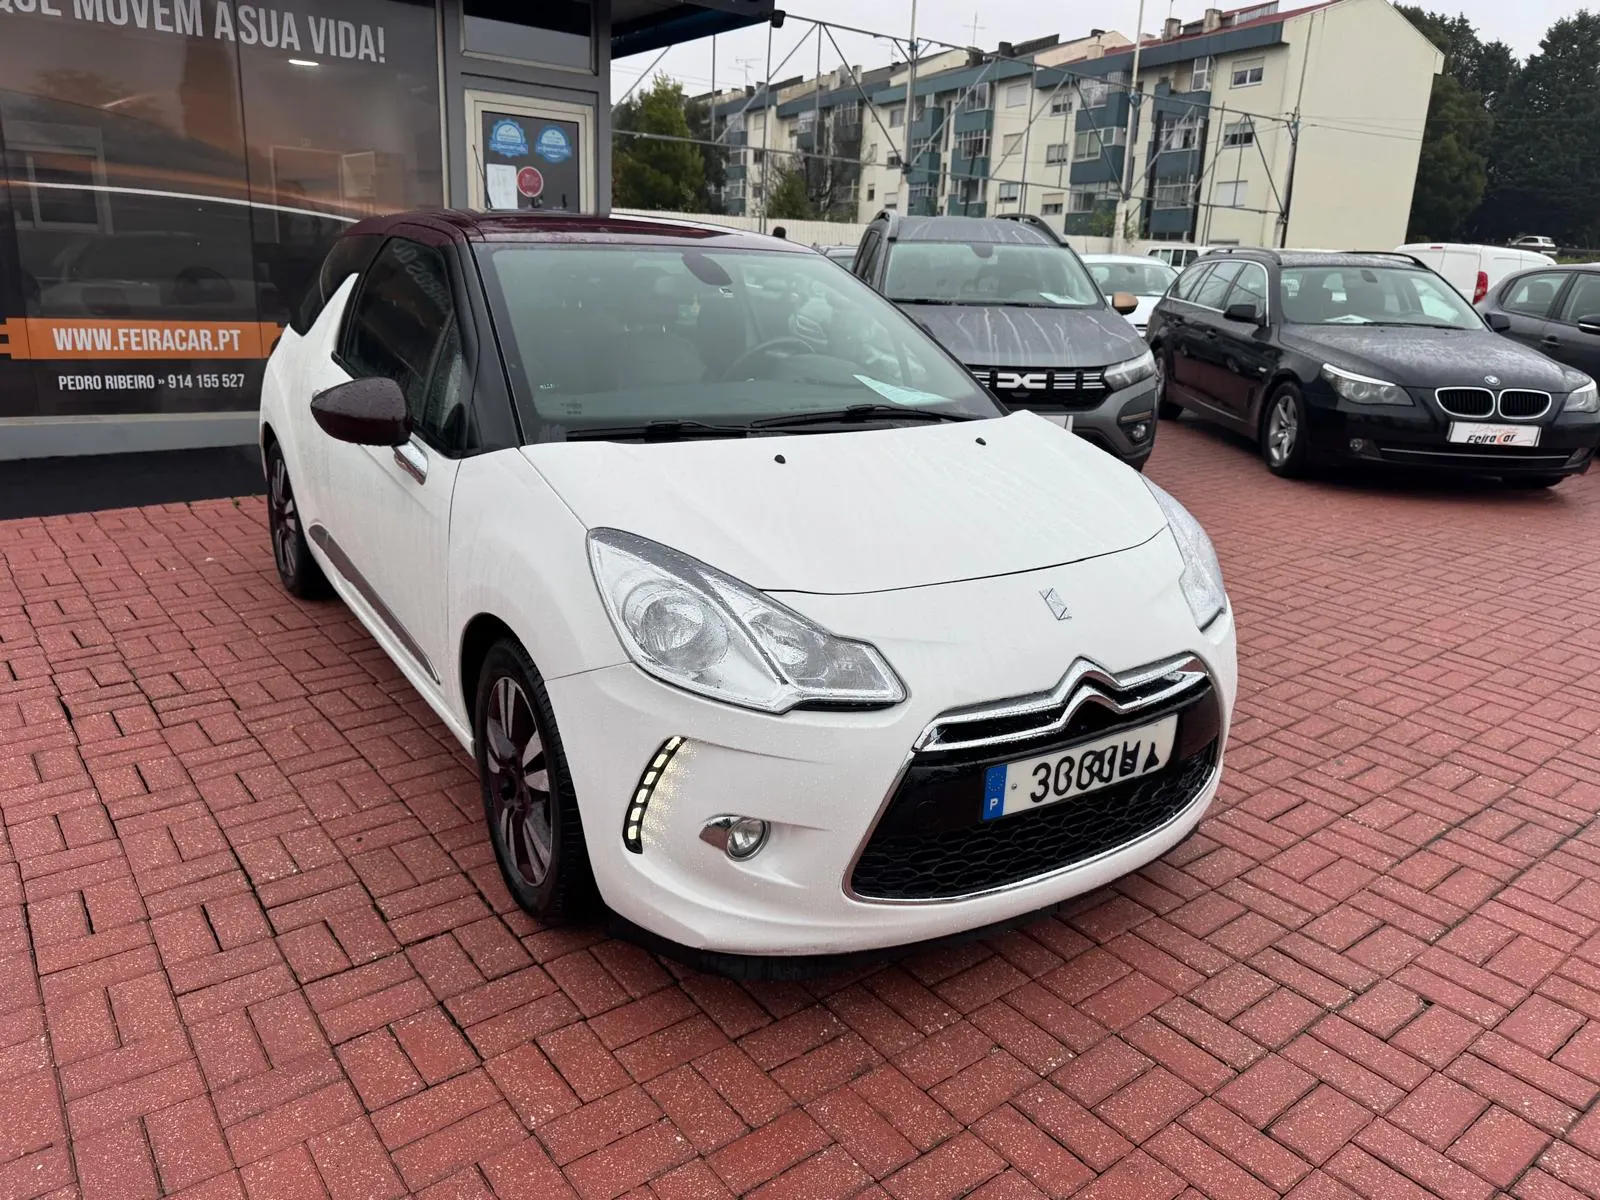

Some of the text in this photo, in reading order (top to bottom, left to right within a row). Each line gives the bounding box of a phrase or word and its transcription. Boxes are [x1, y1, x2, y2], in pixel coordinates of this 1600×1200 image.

[308, 15, 386, 63] VIDA!
[52, 327, 241, 352] WWW.FEIRACAR.PT
[58, 375, 102, 391] PEDRO
[105, 374, 155, 390] RIBEIRO
[168, 374, 193, 389] 914
[197, 374, 219, 389] 155
[222, 373, 245, 388] 527
[989, 797, 999, 811] P
